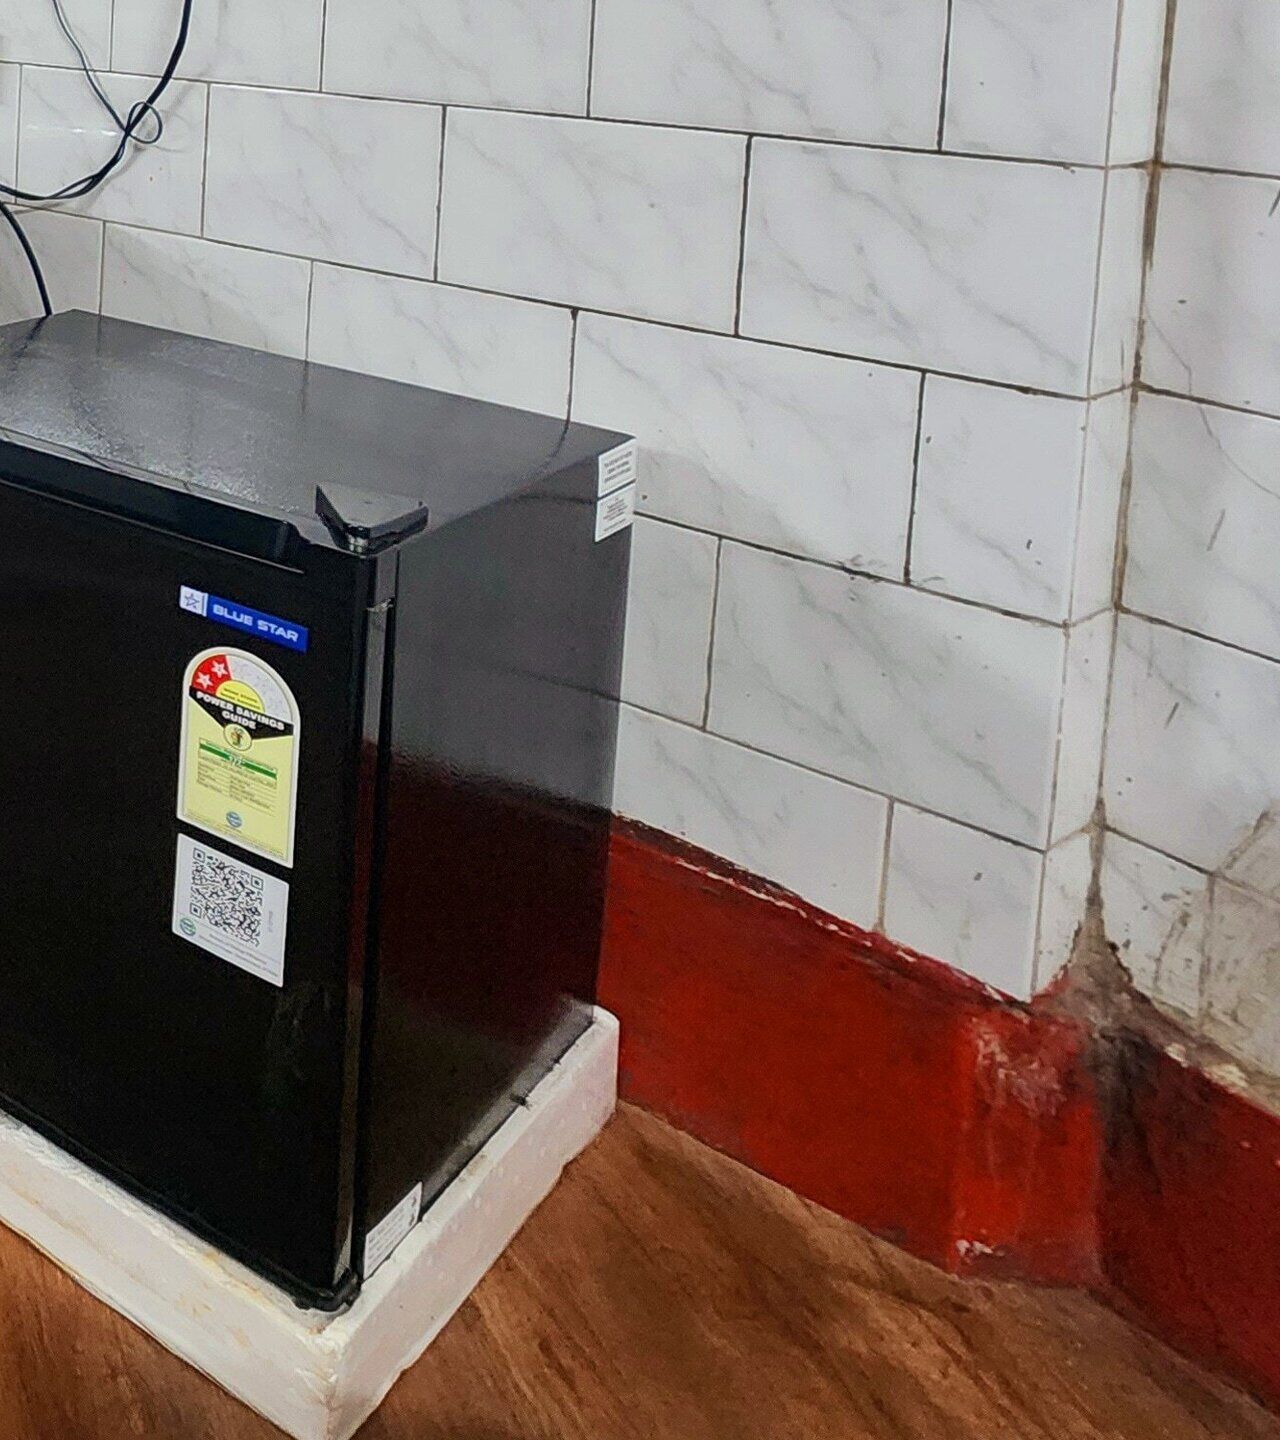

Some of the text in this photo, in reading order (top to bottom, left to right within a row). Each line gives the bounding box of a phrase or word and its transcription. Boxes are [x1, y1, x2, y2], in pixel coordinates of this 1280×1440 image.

[212, 604, 299, 642] BLUE STAR
[196, 691, 235, 713] POWER
[236, 707, 285, 731] SAVINGS
[221, 710, 257, 730] GUIDE
